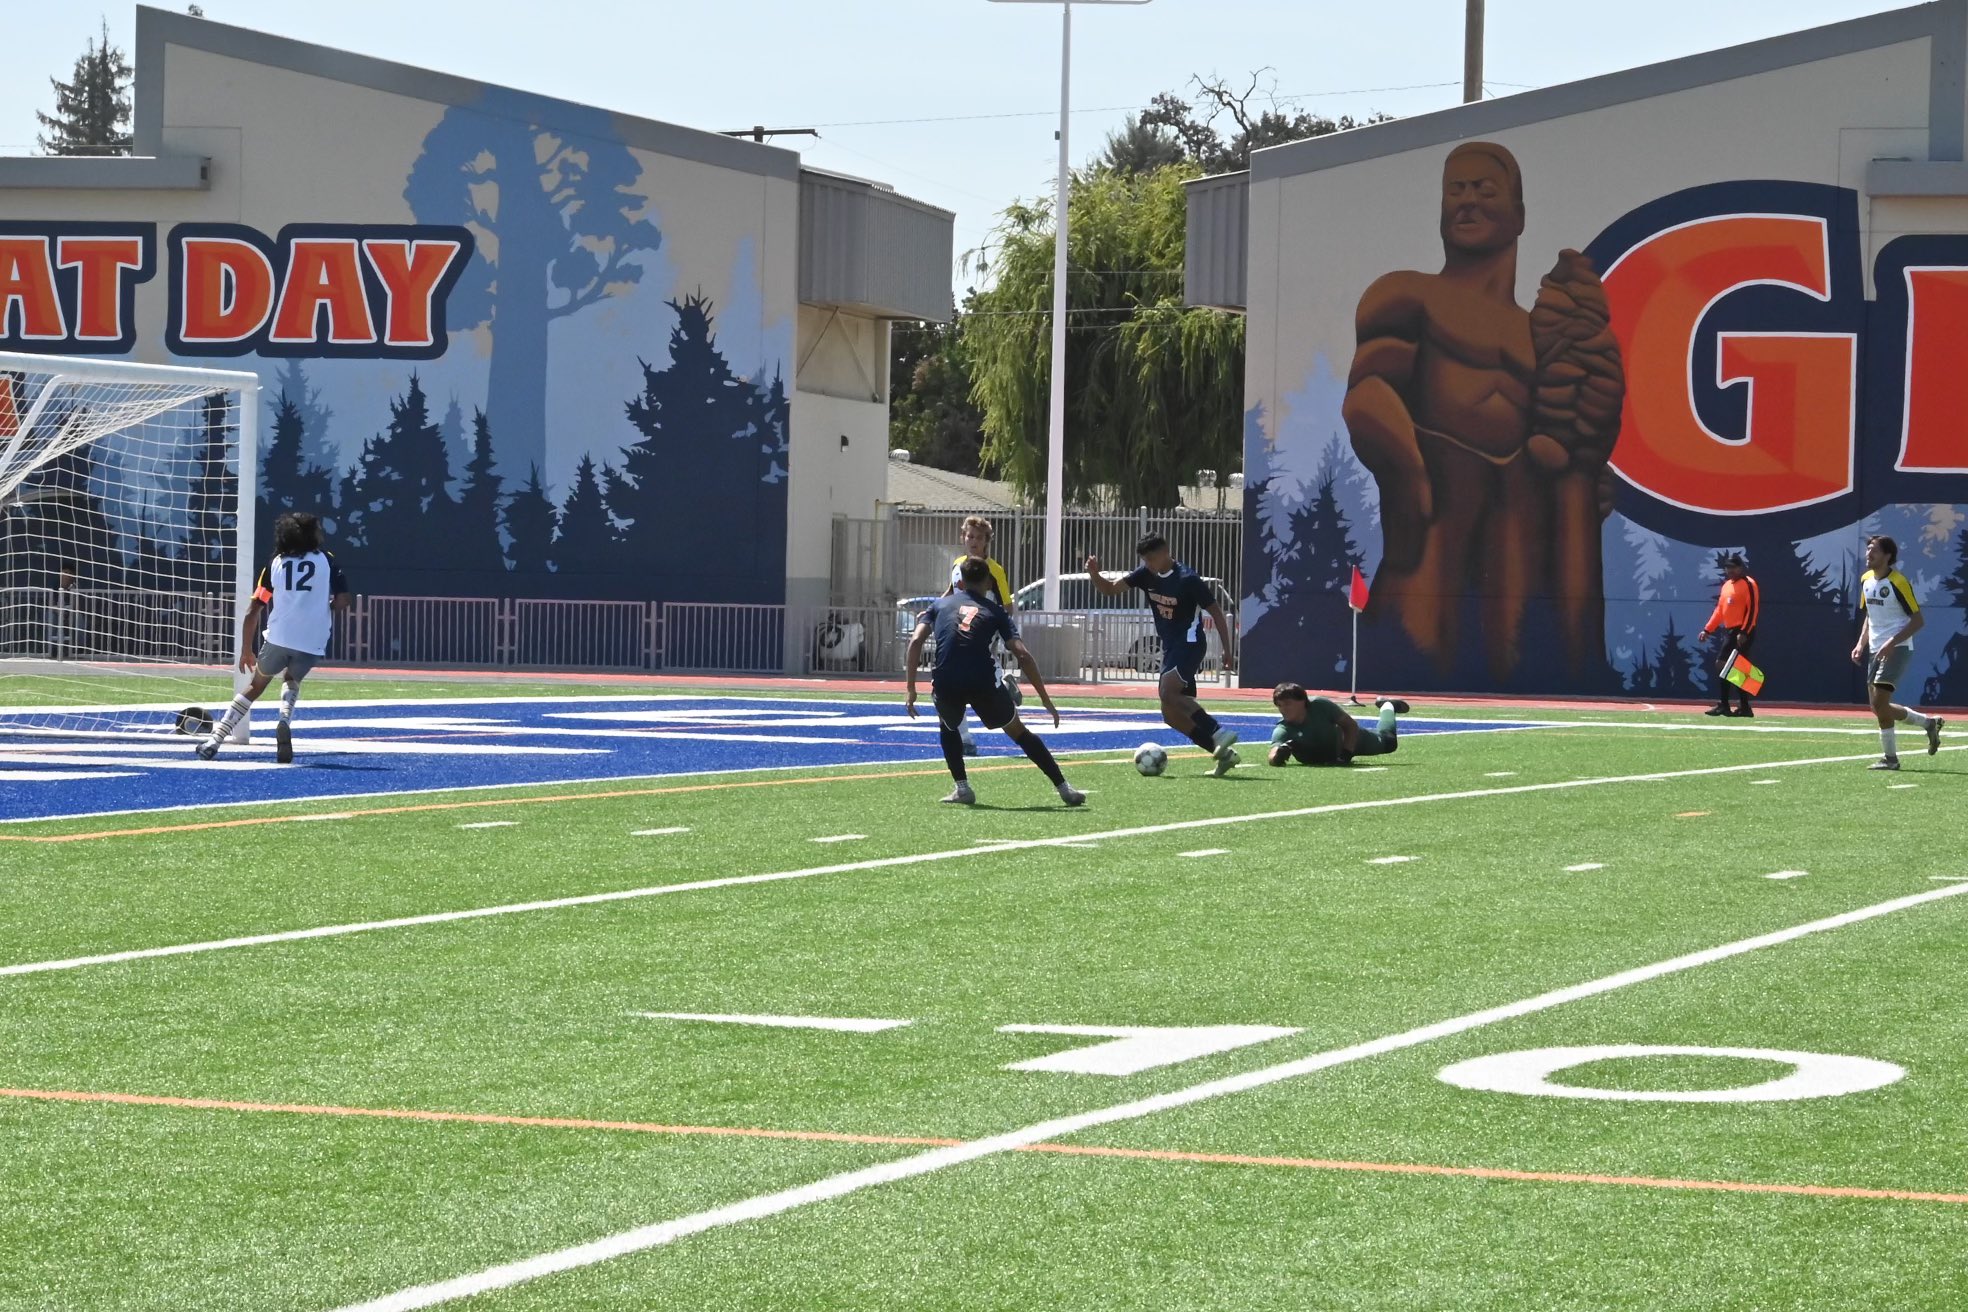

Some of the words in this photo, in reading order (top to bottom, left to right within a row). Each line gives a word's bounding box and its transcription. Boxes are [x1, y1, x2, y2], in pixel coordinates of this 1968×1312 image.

[180, 237, 460, 346] DAY
[282, 560, 316, 592] 12
[958, 605, 979, 632] 7
